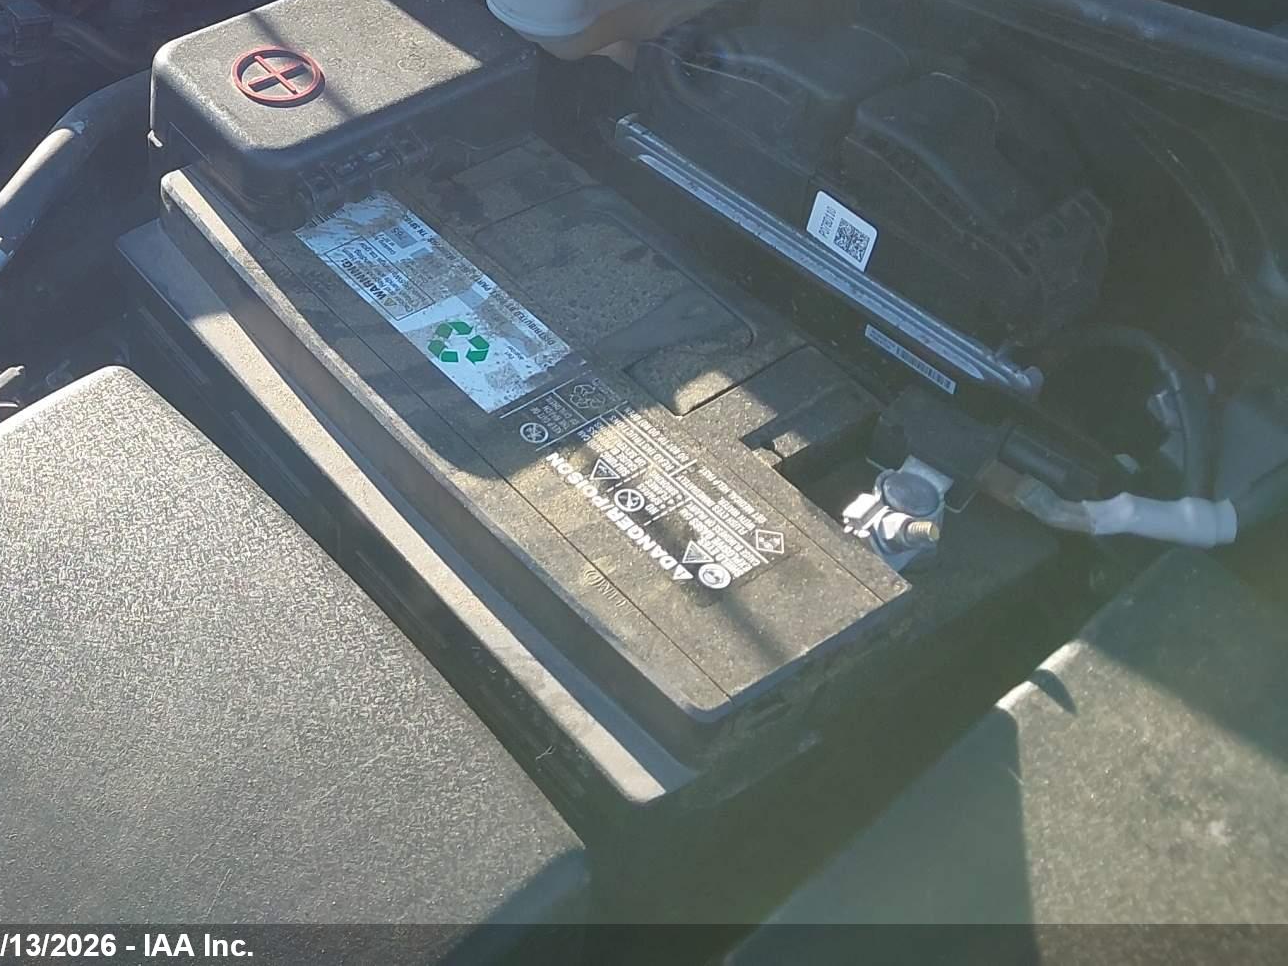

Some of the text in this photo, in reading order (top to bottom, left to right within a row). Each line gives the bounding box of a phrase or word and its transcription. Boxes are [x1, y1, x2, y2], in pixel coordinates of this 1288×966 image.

[416, 227, 429, 236] TN
[337, 257, 387, 299] WARNING:
[512, 310, 555, 346] DISTRIBUTED
[576, 429, 591, 441] CAN
[606, 412, 674, 471] READ INSTRUCTIONS
[599, 450, 631, 477] SULFURIC
[630, 478, 664, 505] SPARKS
[643, 477, 672, 501] FLAMES
[544, 451, 680, 570] DANGER/POISON
[643, 502, 660, 515] NO
[709, 503, 730, 519] EYES
[726, 490, 755, 515] MEDICAL
[724, 515, 748, 535] FLUSH
[736, 513, 757, 530] WITH
[677, 507, 754, 573] EXPLOSIVE GASES CAN
[713, 552, 745, 577] SHIELD
